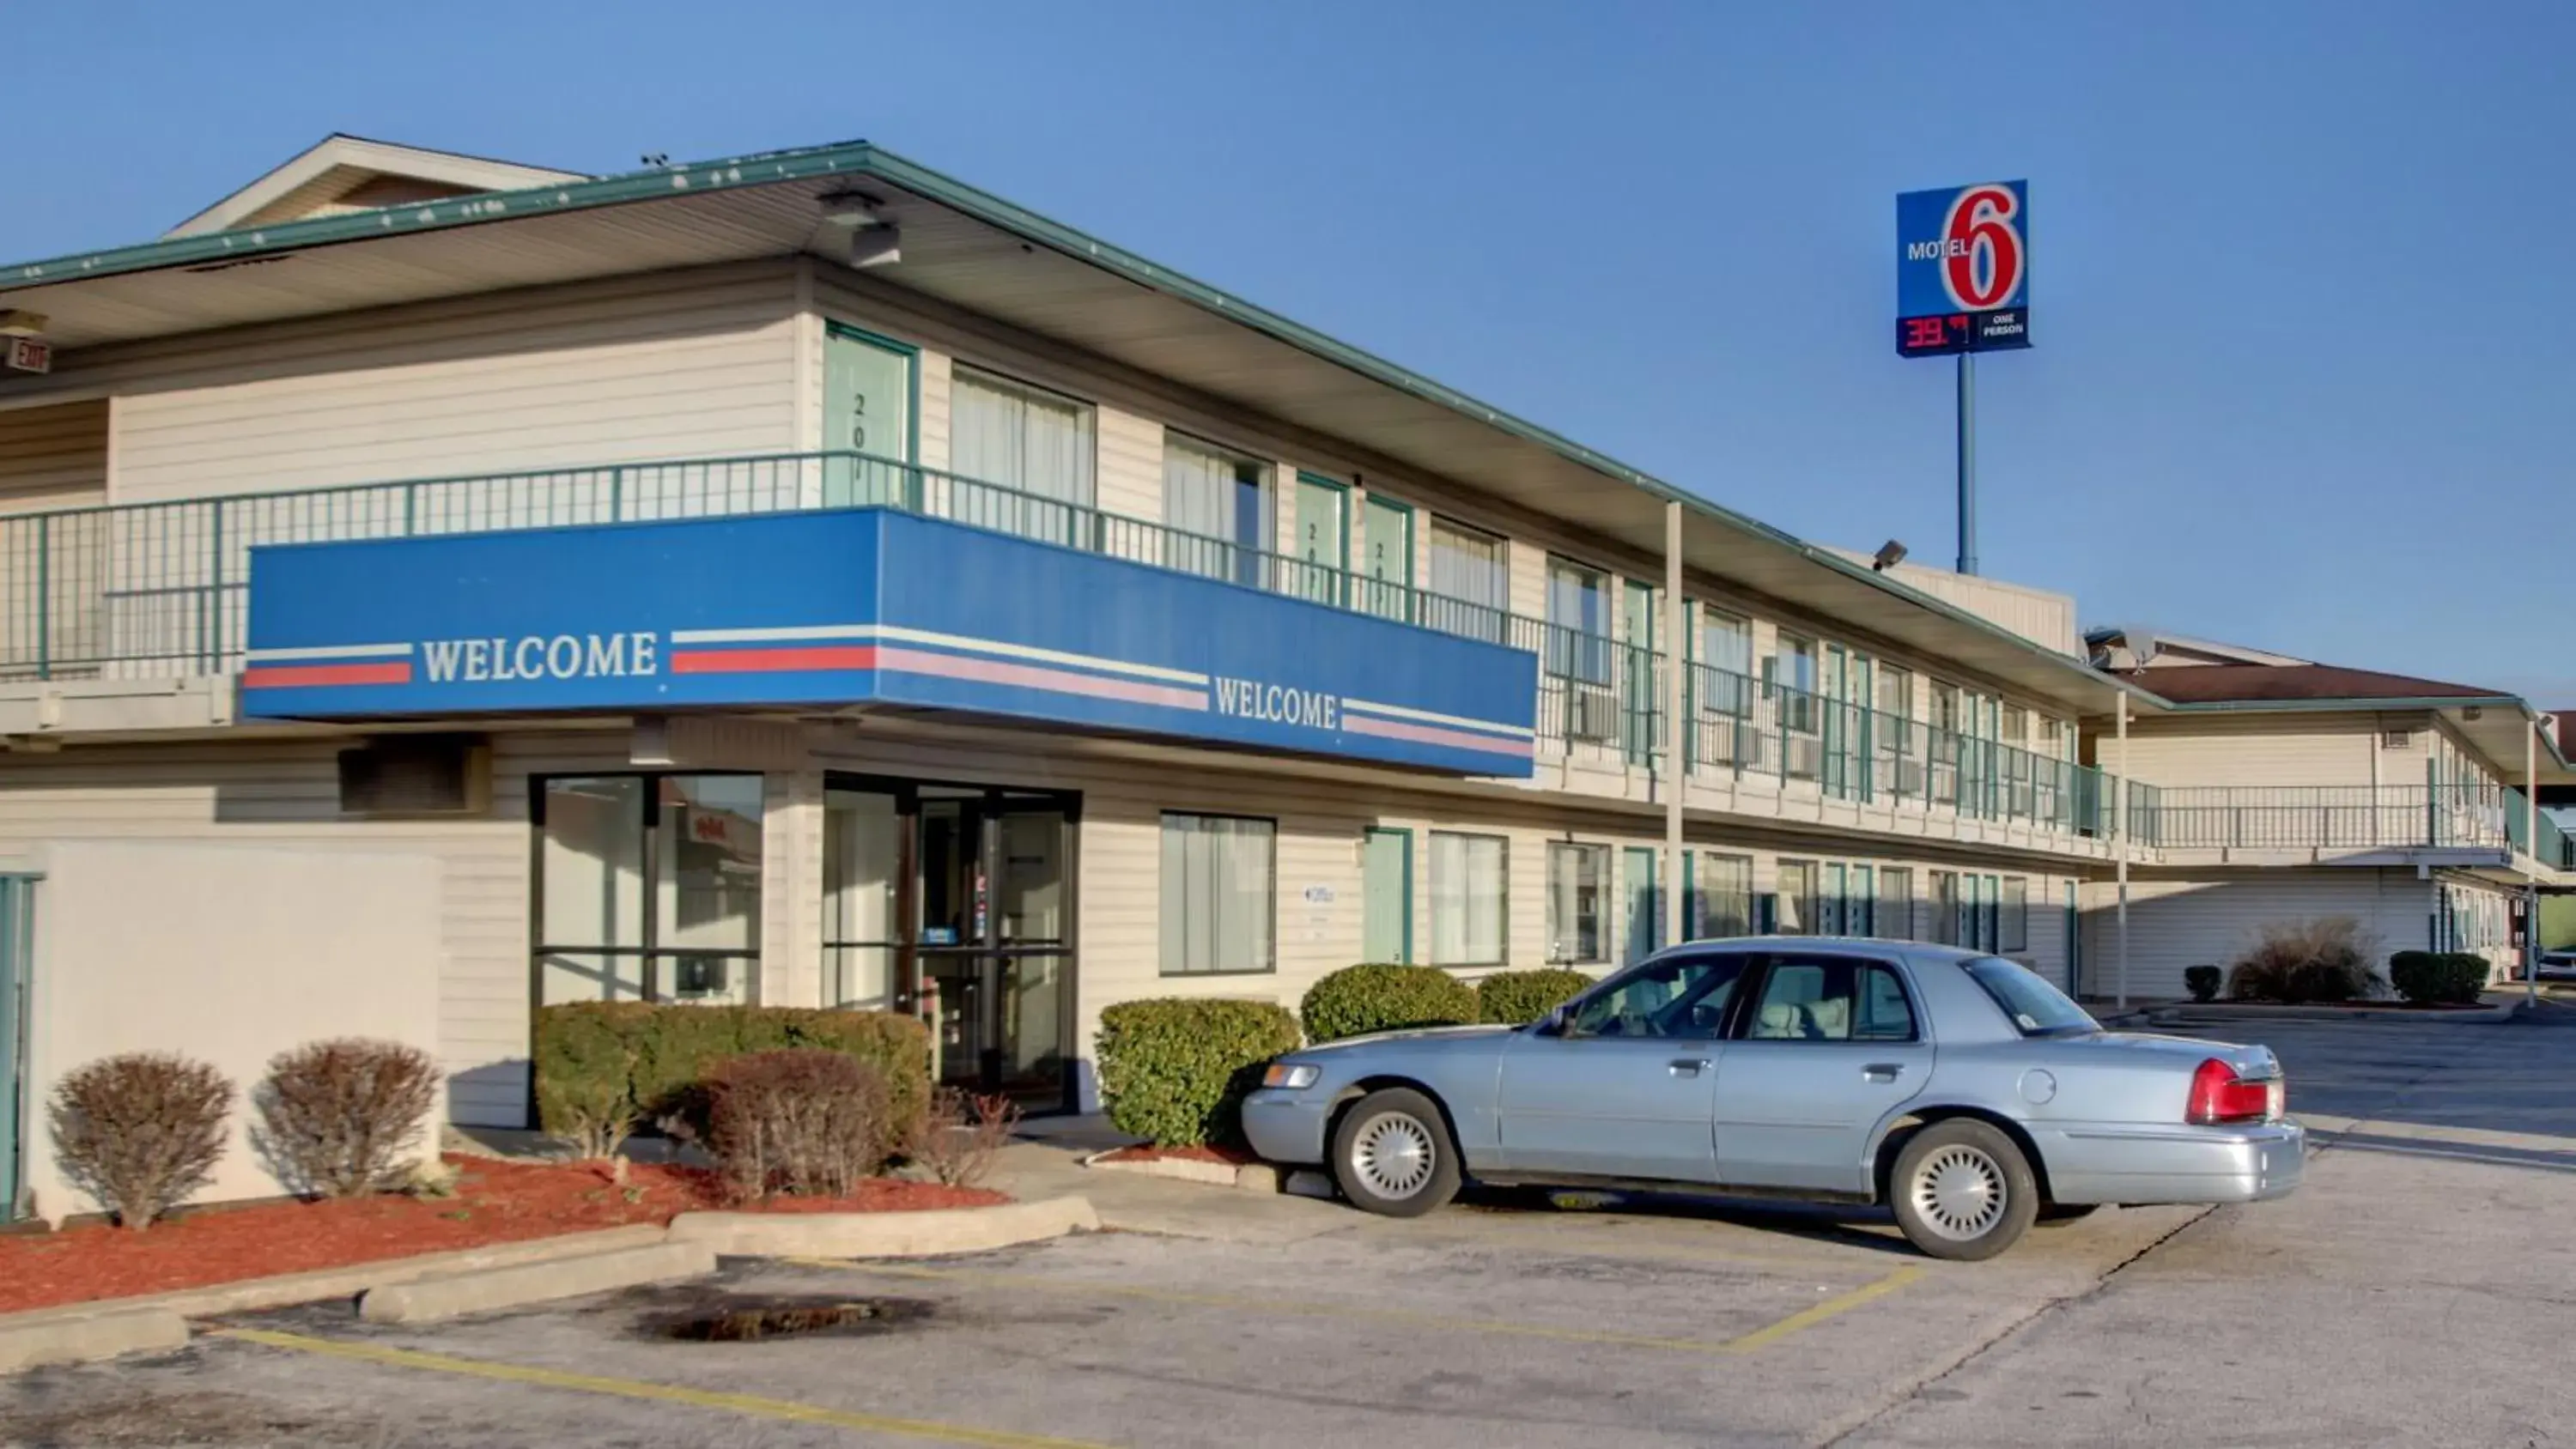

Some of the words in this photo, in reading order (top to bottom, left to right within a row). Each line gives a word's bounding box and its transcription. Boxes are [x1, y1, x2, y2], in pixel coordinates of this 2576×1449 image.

[1908, 239, 1970, 260] MOTEL
[1941, 185, 2023, 311] 6
[1984, 323, 2024, 337] PERSON
[1993, 313, 2015, 324] ONE
[422, 632, 658, 683] WELCOME
[1215, 676, 1336, 730] WELCOME
